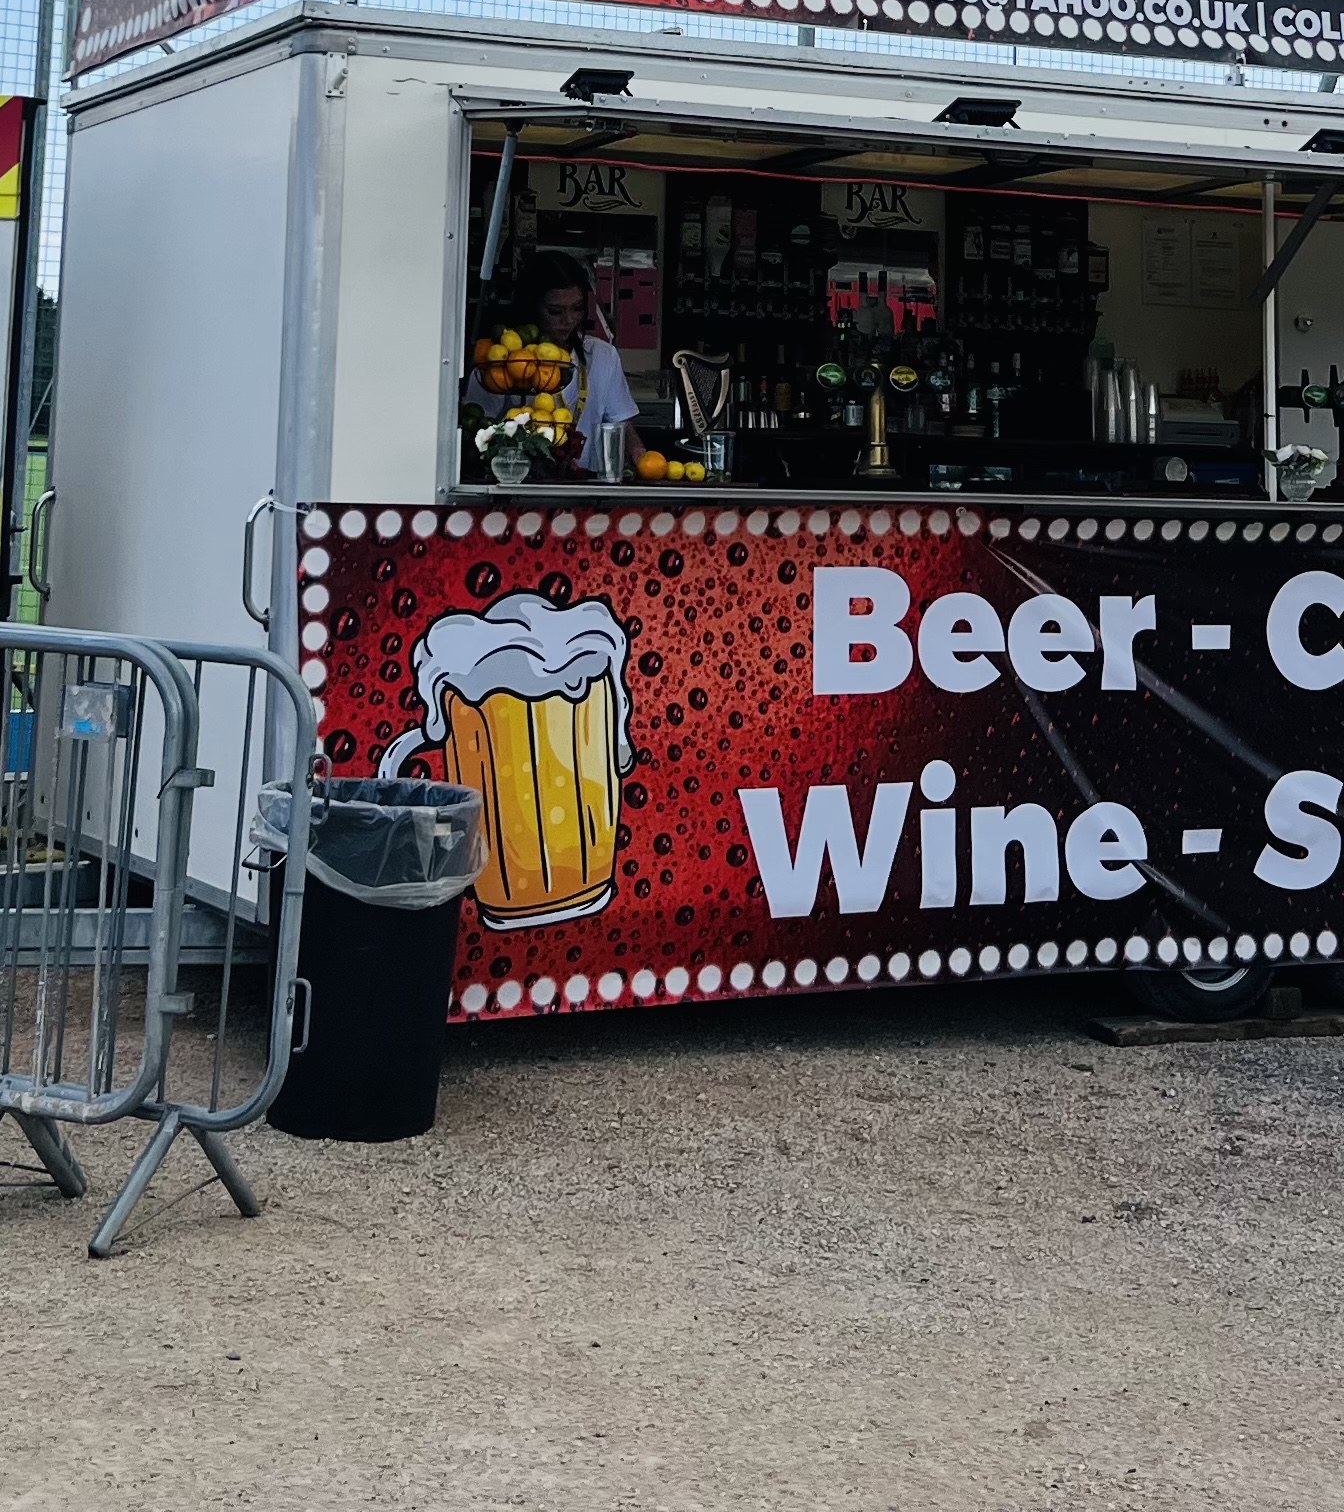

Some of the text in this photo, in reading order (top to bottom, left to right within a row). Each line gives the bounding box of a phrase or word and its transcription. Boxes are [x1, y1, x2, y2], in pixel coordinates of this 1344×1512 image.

[557, 162, 642, 208] BAR
[845, 182, 922, 224] BAR
[813, 567, 1156, 695] Beer
[738, 760, 1147, 918] Wine
